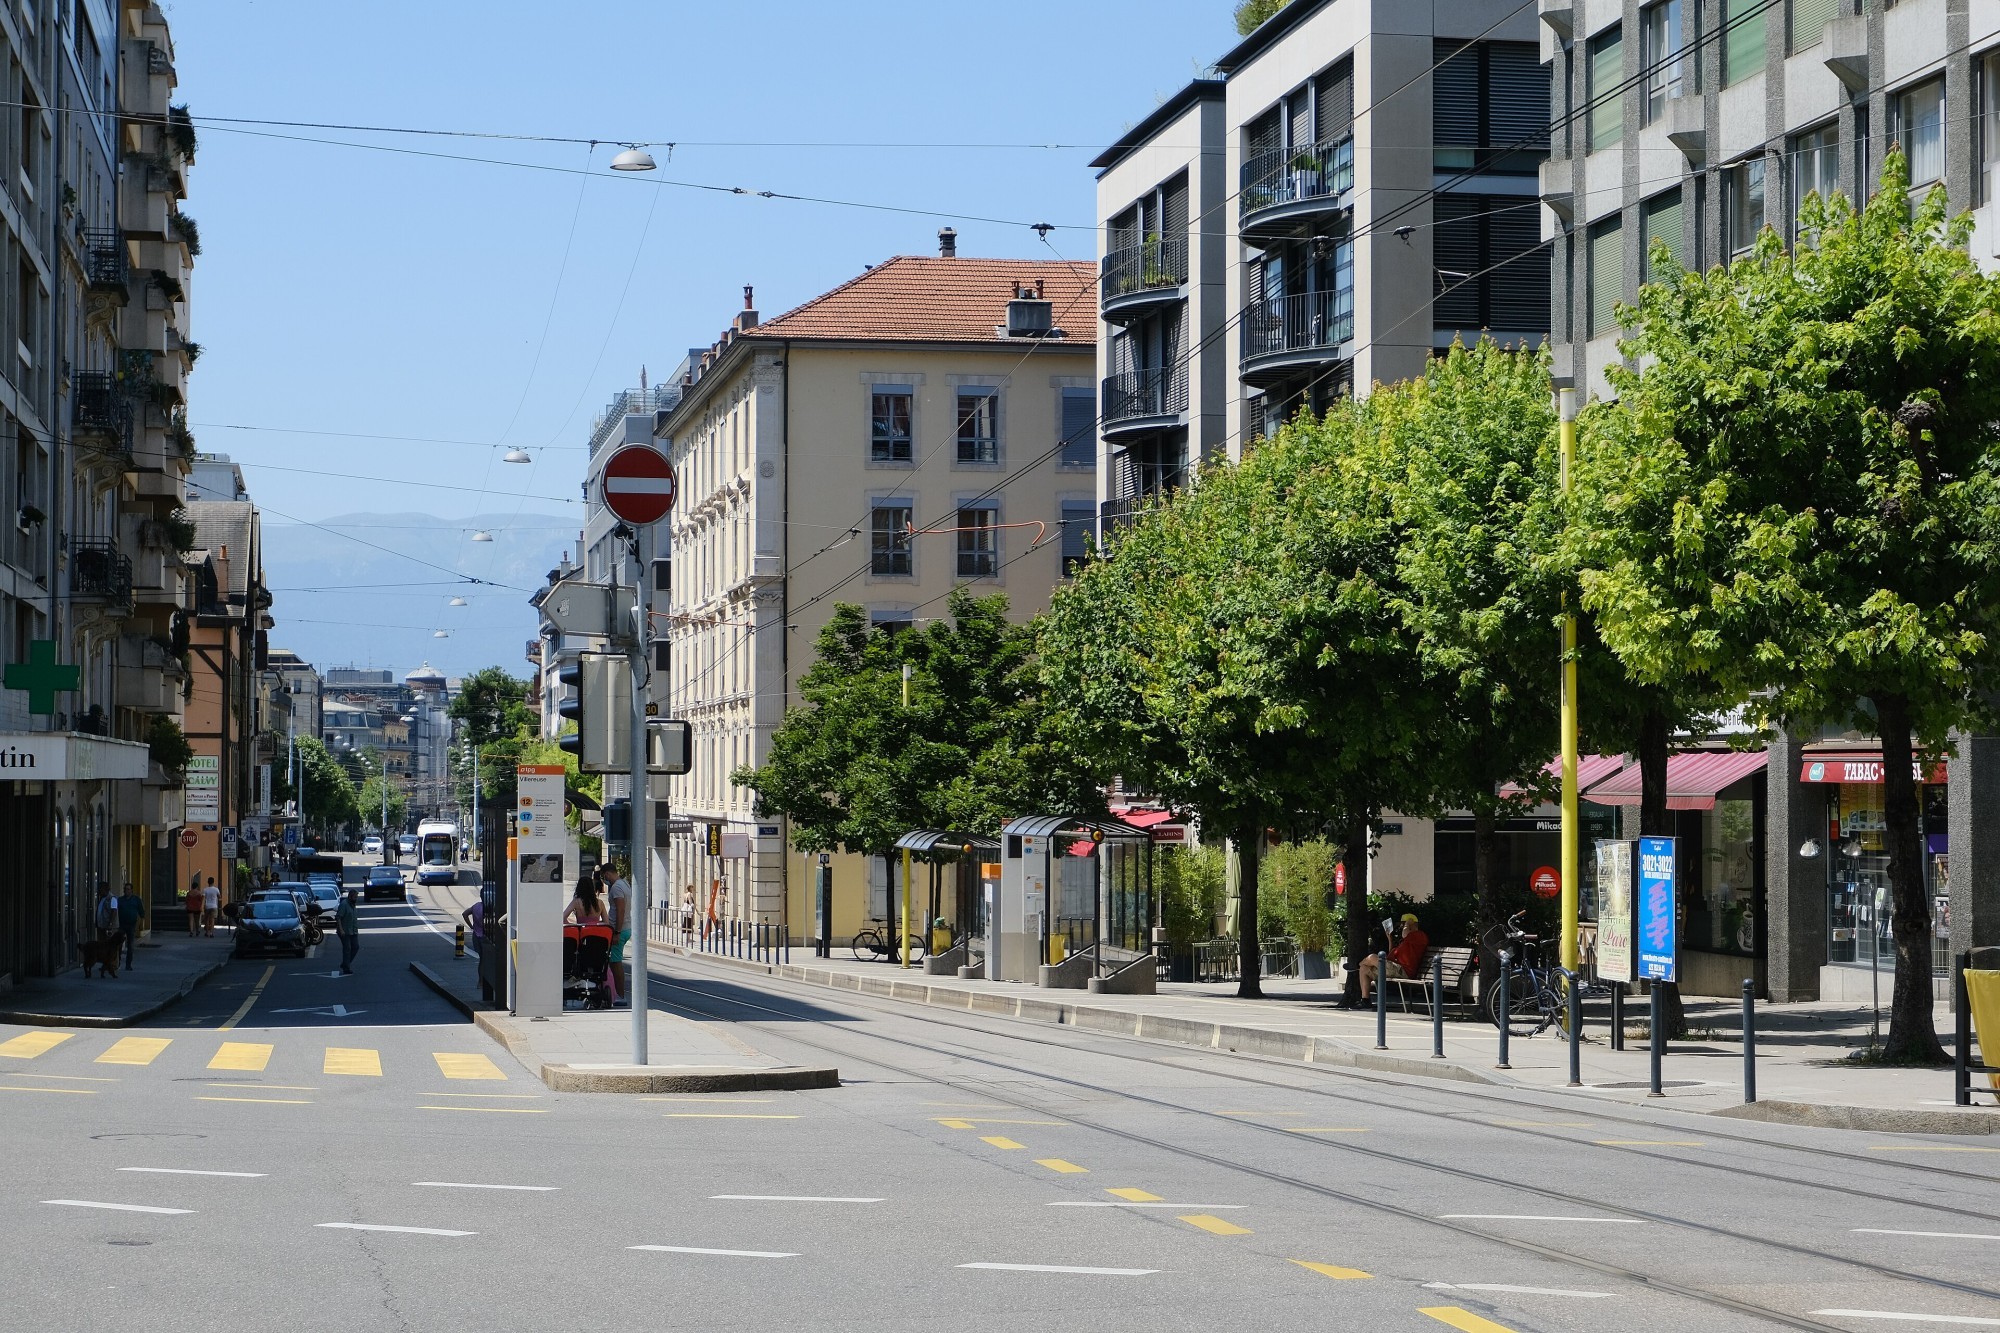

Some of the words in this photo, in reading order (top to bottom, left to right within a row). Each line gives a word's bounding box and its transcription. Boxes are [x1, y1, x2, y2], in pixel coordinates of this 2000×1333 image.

[0, 746, 36, 768] tin
[1844, 762, 1879, 781] TABAC
[1536, 821, 1562, 830] Mikad
[710, 825, 718, 855] TABACS
